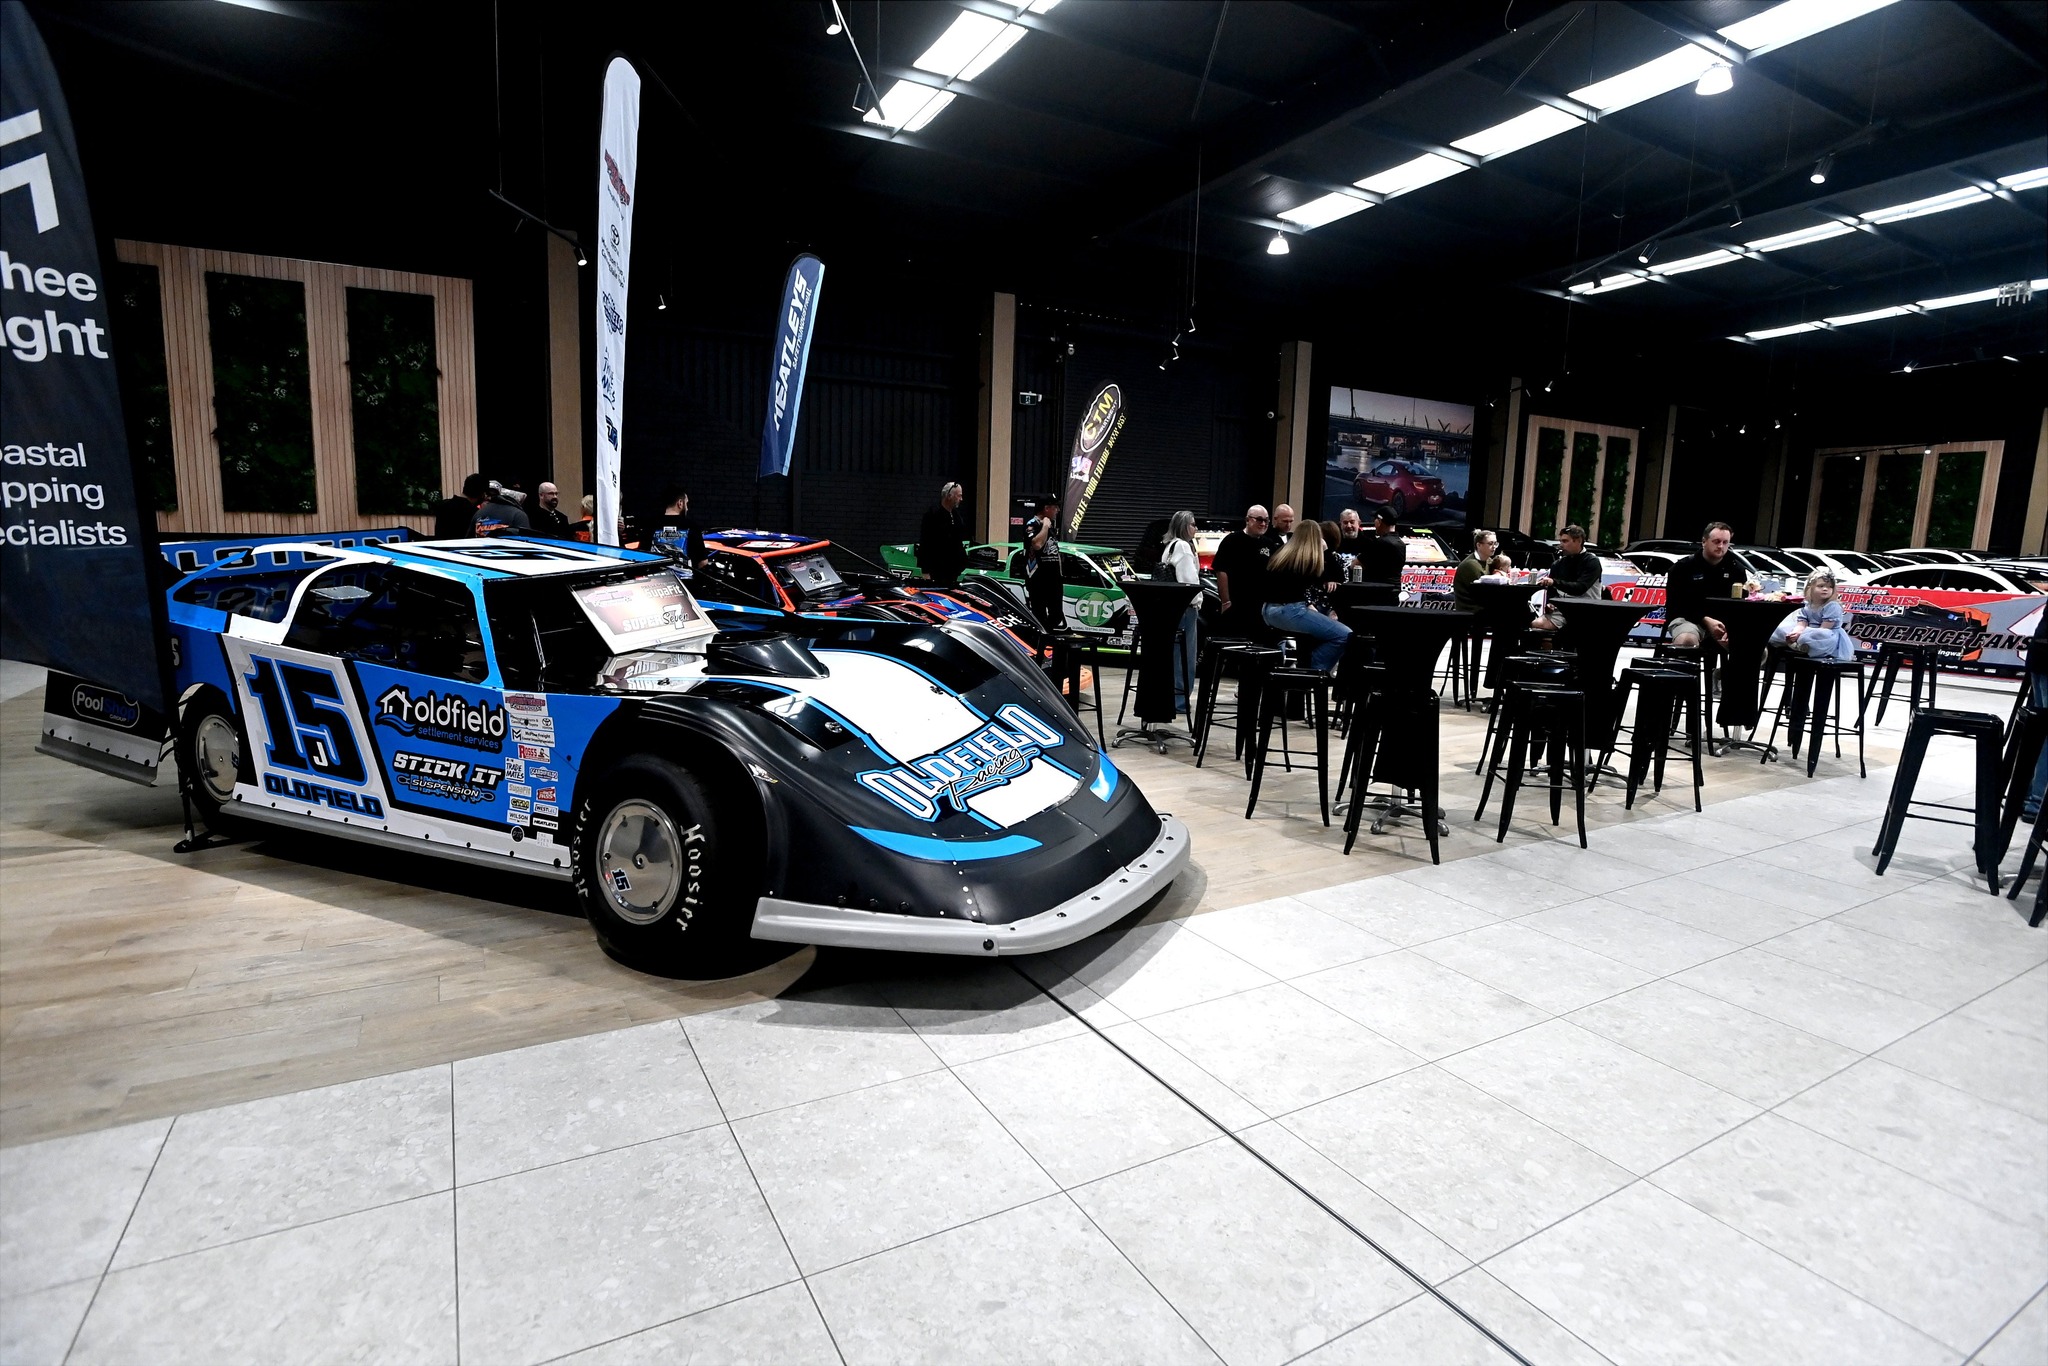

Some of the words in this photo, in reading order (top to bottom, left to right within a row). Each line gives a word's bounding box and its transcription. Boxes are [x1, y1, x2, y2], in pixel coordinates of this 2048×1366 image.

[773, 269, 808, 431] HEATLEYS
[1084, 392, 1114, 440] CTM
[0, 443, 86, 467] astal
[1084, 477, 1098, 499] YOUR
[1094, 447, 1110, 479] FUTURE
[0, 477, 104, 509] pping
[1075, 600, 1113, 618] GTS
[1630, 588, 1666, 605] DIR
[1841, 594, 1871, 603] DIRT
[1873, 595, 1920, 606] SERIES
[1906, 627, 1972, 647] RACE
[1969, 632, 2033, 650] FANS
[248, 655, 367, 785] 15
[415, 695, 504, 736] oldfield
[418, 726, 462, 742] settlement
[464, 735, 499, 749] services
[394, 753, 466, 779] STICK
[472, 767, 501, 785] IT
[506, 763, 522, 771] TRADE
[506, 771, 524, 779] MATES
[860, 705, 1063, 820] OLDFIELD
[412, 779, 479, 797] SUSPENSION
[937, 747, 1039, 811] Racing
[265, 774, 384, 818] OLDFIELD
[611, 869, 632, 891] 15
[677, 823, 706, 931] Hoosier
